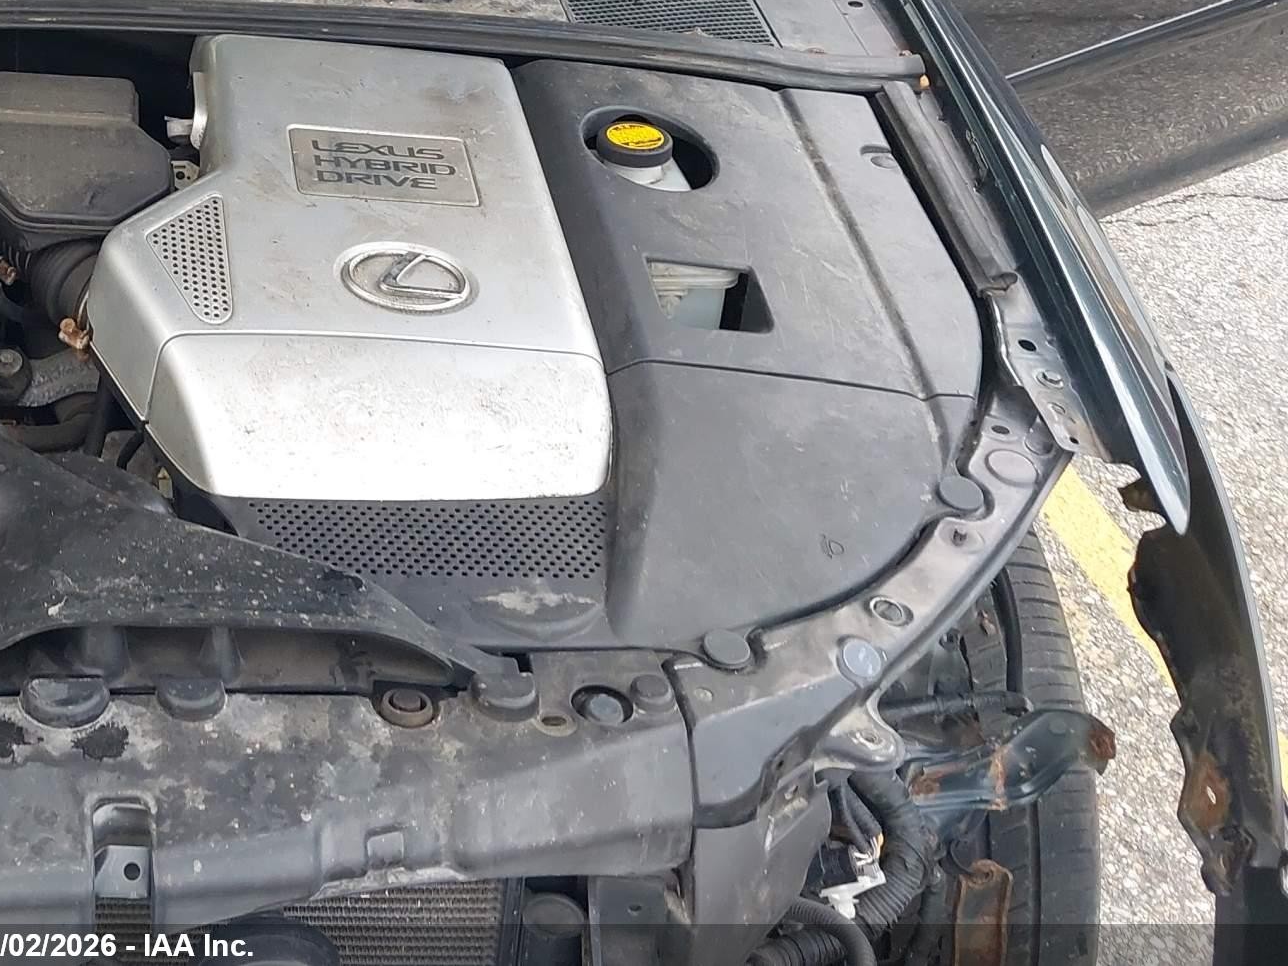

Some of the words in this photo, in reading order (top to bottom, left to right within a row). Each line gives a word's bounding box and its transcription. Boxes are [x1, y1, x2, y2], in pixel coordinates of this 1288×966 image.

[312, 140, 444, 160] LEXUS
[314, 154, 456, 176] HYBRID
[317, 169, 438, 190] DRIVE
